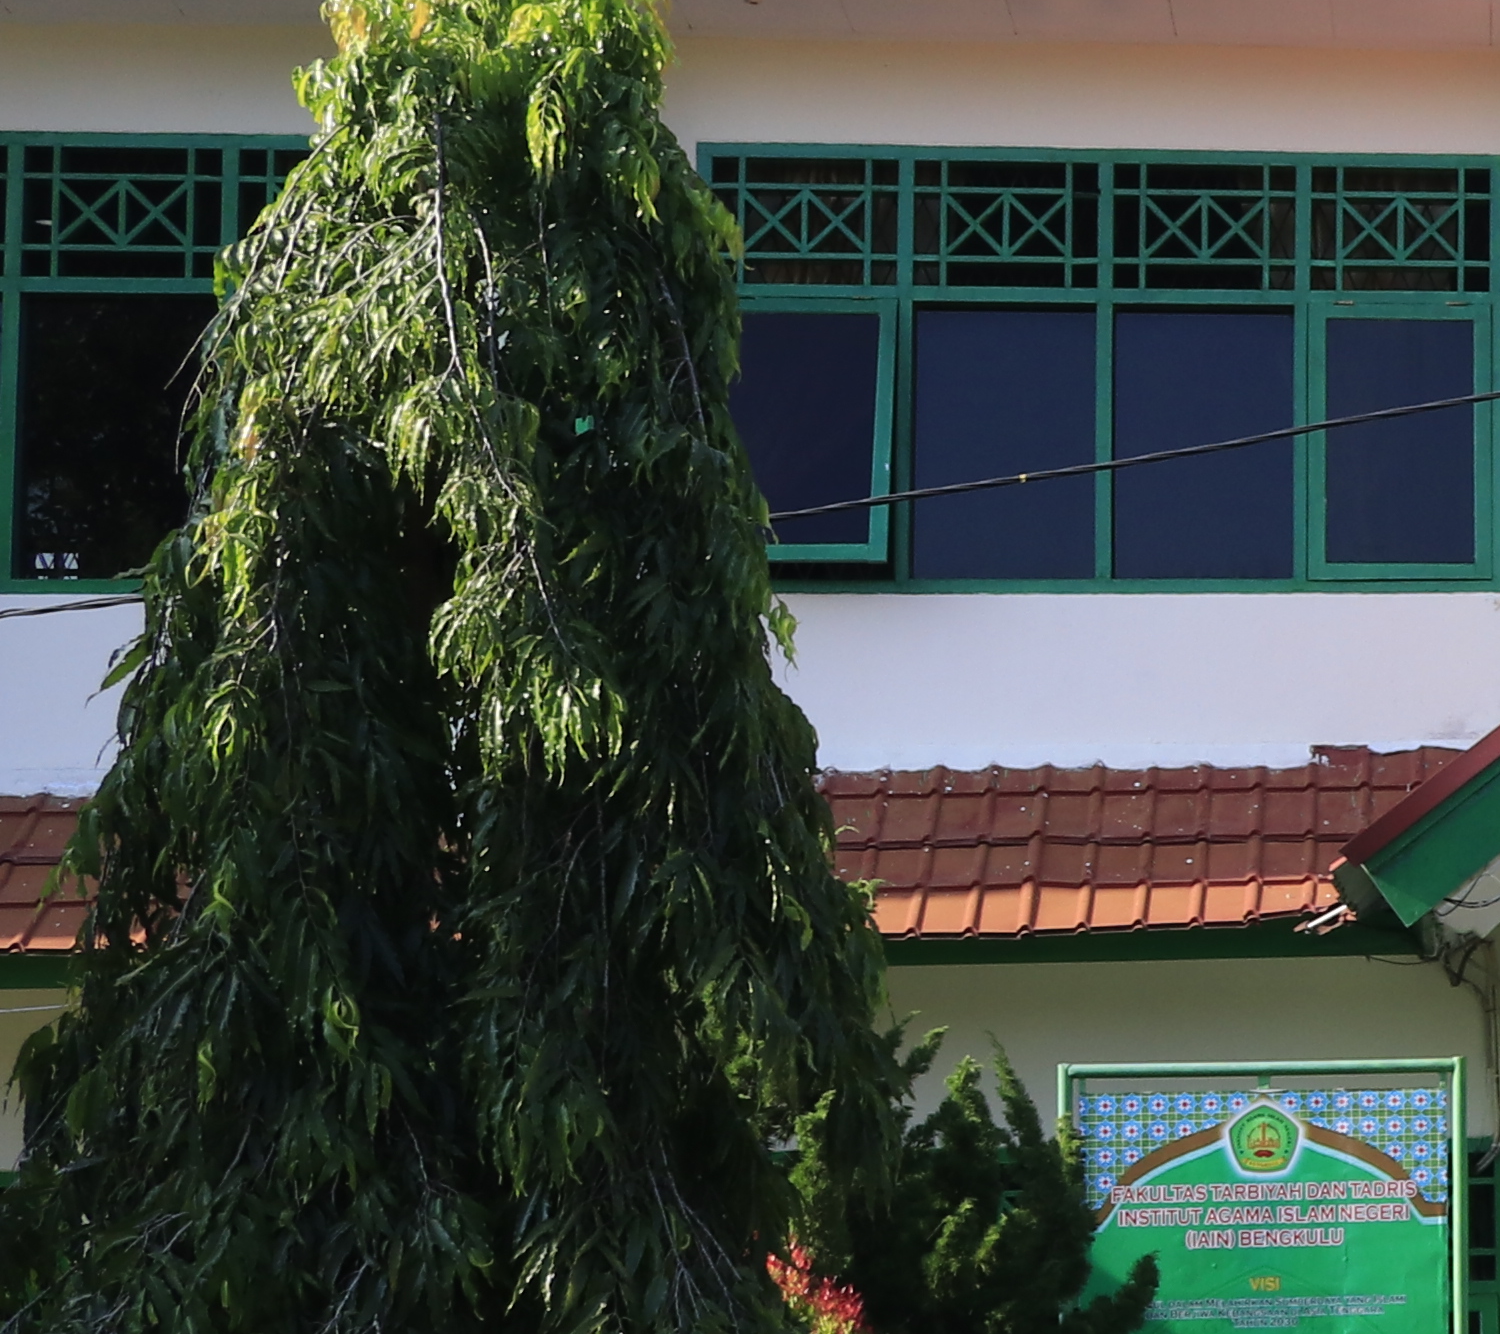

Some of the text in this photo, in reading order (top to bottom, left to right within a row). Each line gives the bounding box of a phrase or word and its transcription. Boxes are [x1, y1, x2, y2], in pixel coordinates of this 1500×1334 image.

[1110, 1179, 1417, 1204] FAKULTAS TARBIYAH DAN TADRIS
[1118, 1204, 1410, 1227] INSTITUT AGAMA ISLAM NEGERI
[1185, 1227, 1345, 1250] (IAIN) BENGKULU
[1250, 1276, 1280, 1291] VISI
